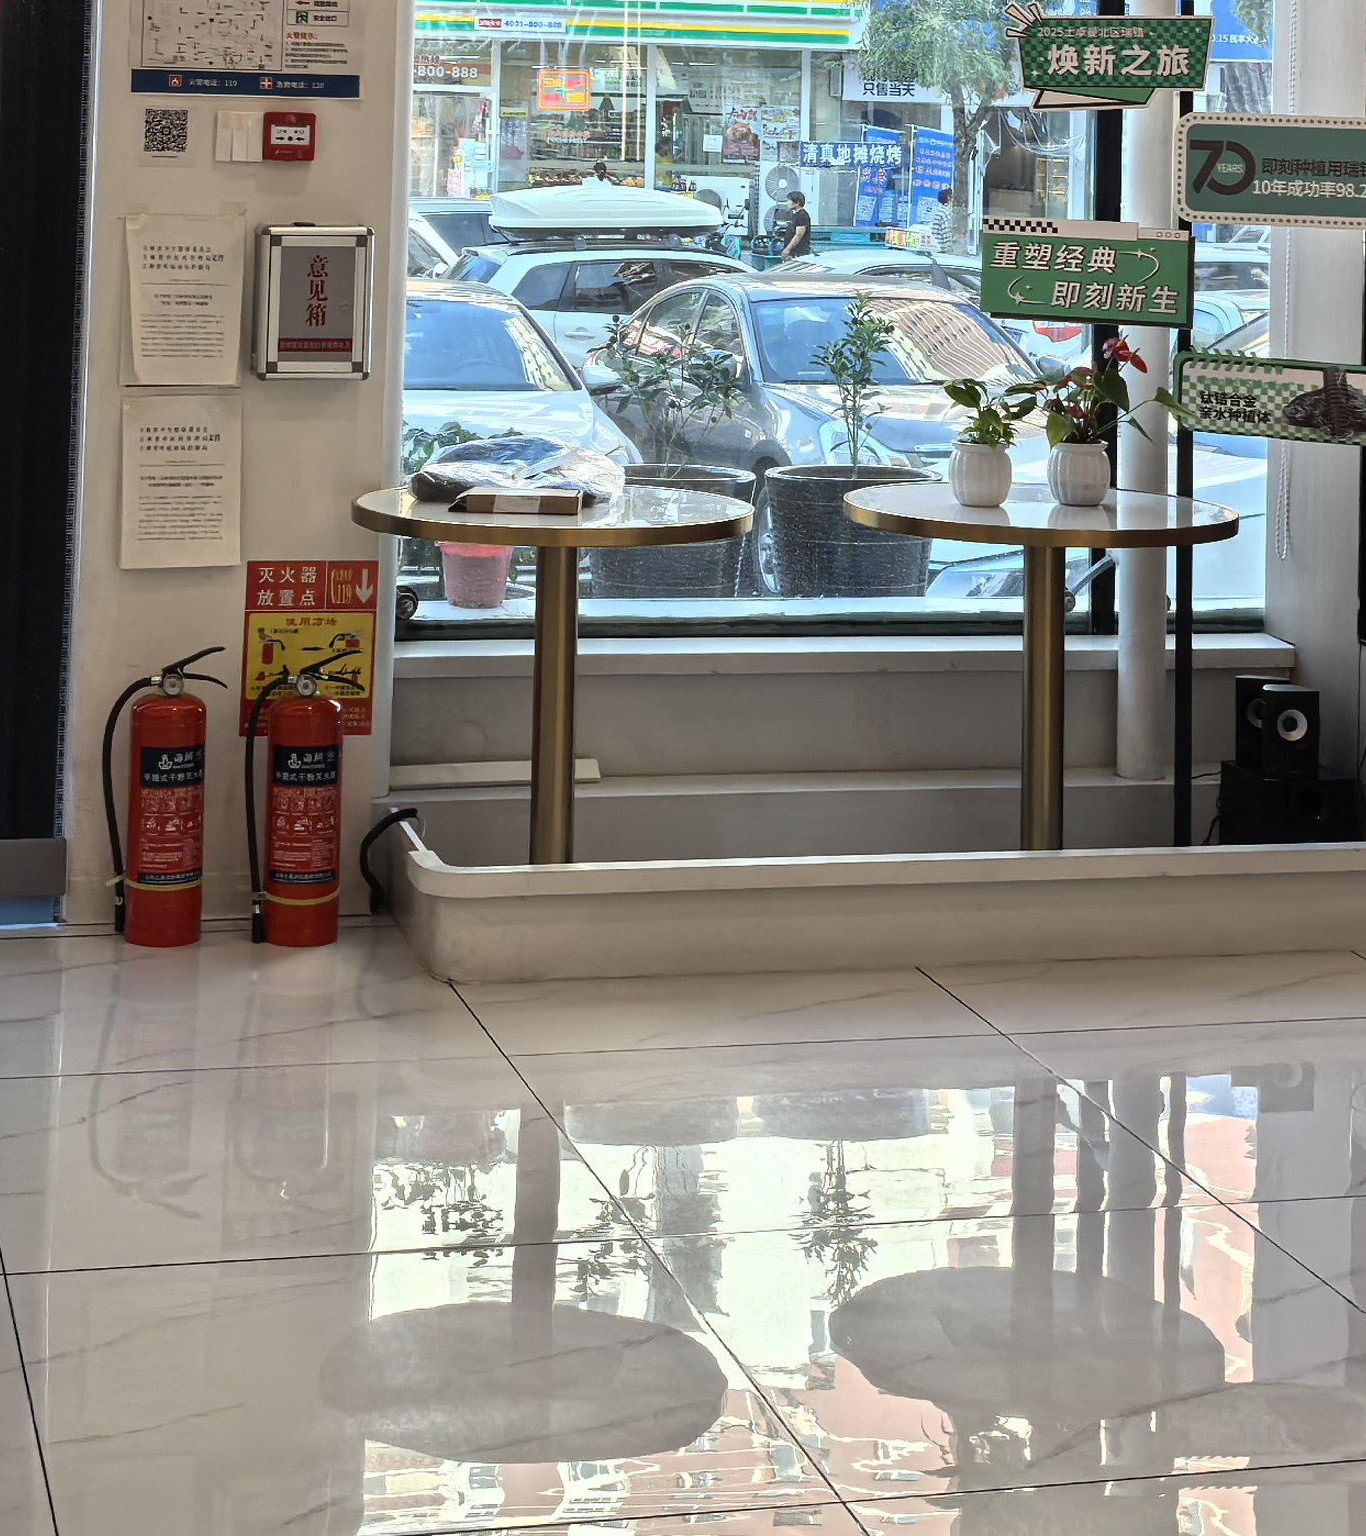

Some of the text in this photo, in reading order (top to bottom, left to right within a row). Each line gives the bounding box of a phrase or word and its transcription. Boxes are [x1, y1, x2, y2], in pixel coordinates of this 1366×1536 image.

[1047, 44, 1190, 76] 焕新之旅
[803, 142, 903, 166] 清真地摊烧烤
[1217, 164, 1243, 173] YEARS
[991, 242, 1116, 274] 重塑经典
[305, 254, 329, 328] 意见箱
[1050, 281, 1179, 315] 即刻新生
[1200, 391, 1256, 408] 钛锆合金
[1200, 405, 1271, 424] 亲水种植体
[259, 566, 317, 584] 灭火器
[257, 589, 316, 607] 放置点
